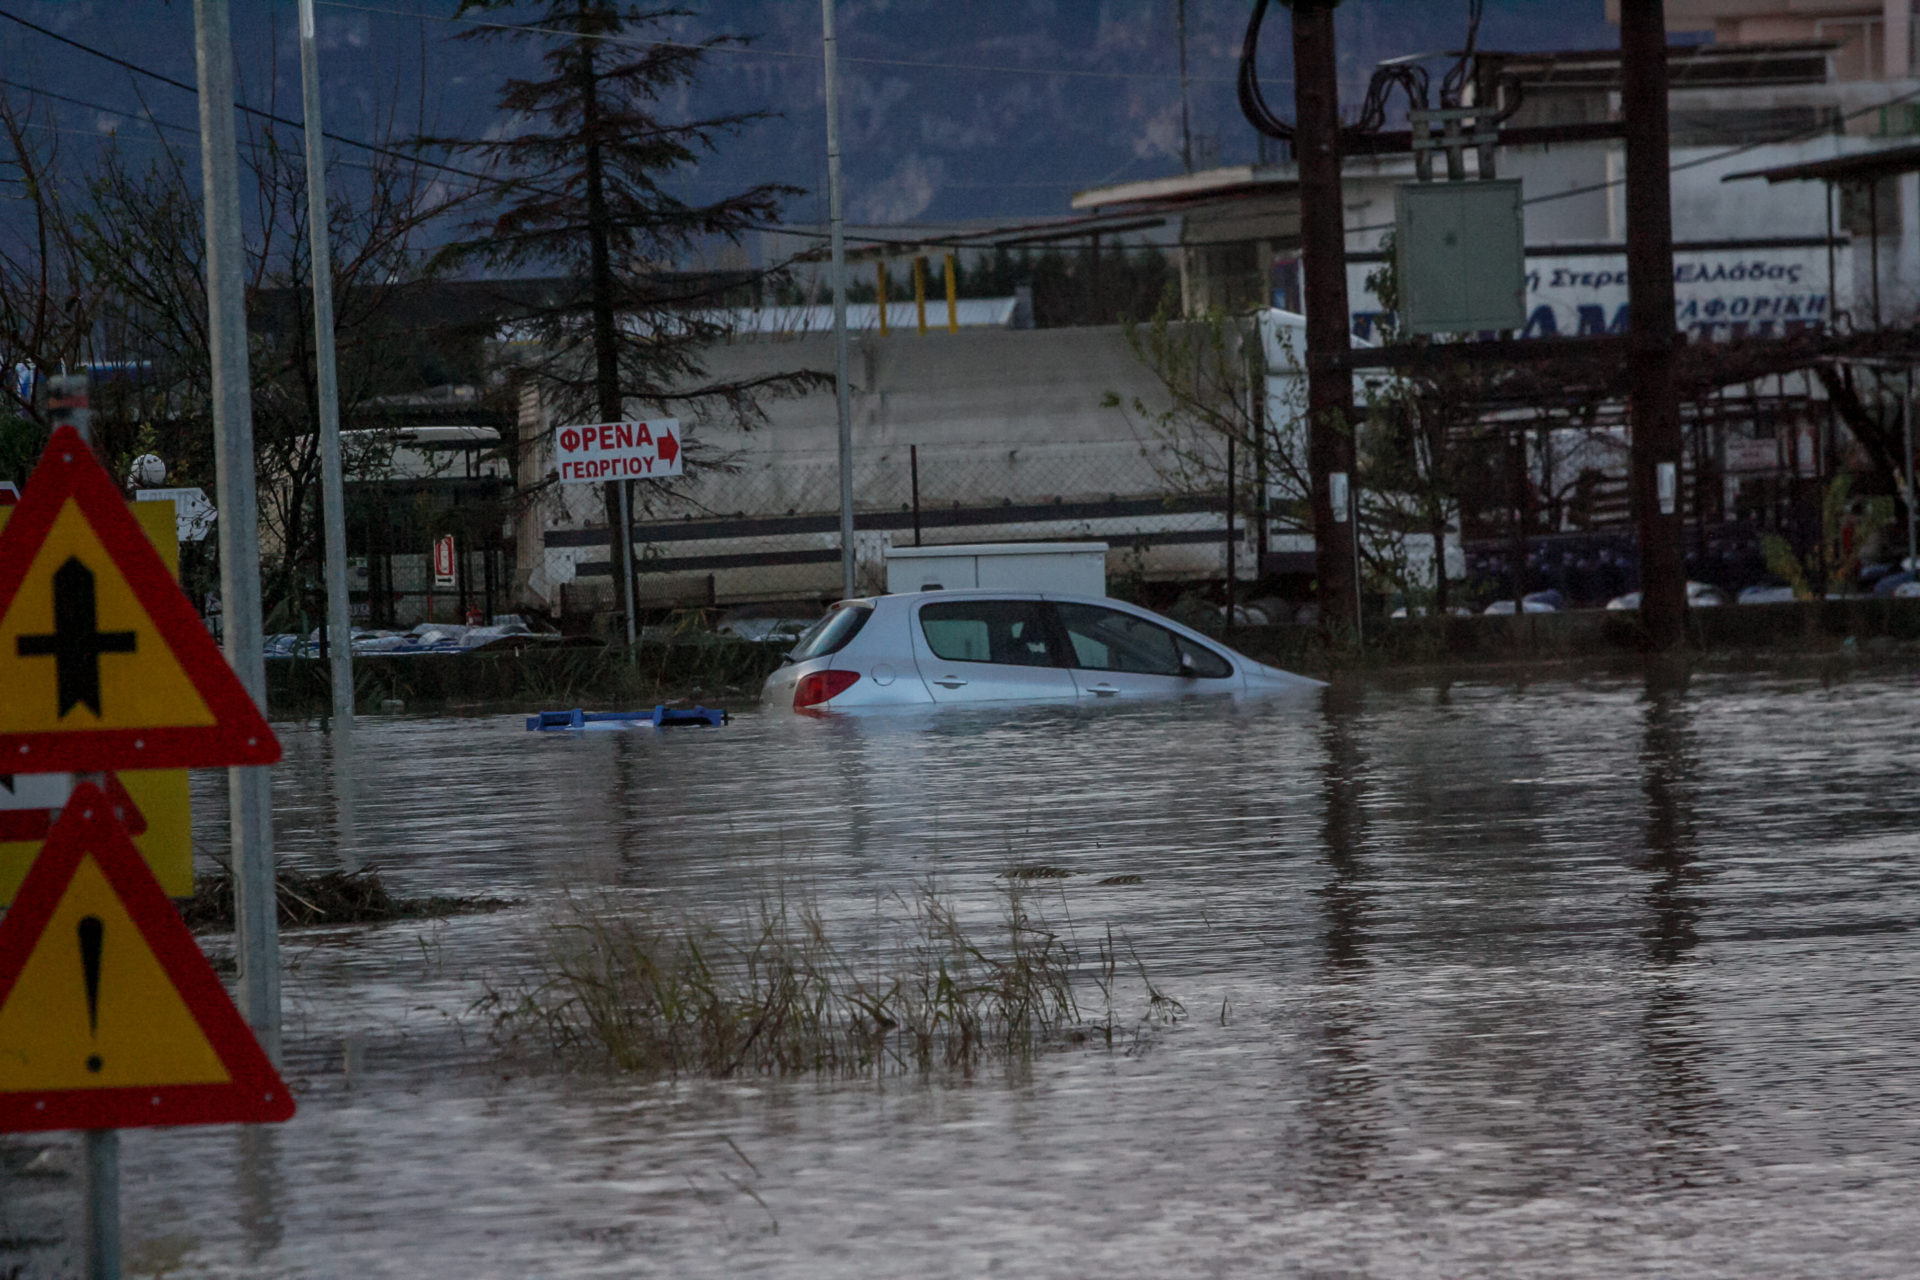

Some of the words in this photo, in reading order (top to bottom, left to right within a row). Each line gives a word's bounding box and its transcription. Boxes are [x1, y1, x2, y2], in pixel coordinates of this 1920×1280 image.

[1550, 268, 1629, 289] Στερε
[1674, 260, 1804, 283] Ελλάδας
[1675, 294, 1827, 320] ΑΦΟΡΙΚΗ
[560, 422, 654, 453] ΦΡΕΝΑ
[562, 456, 655, 479] ΓΕΩΡΓΙΟΥ
